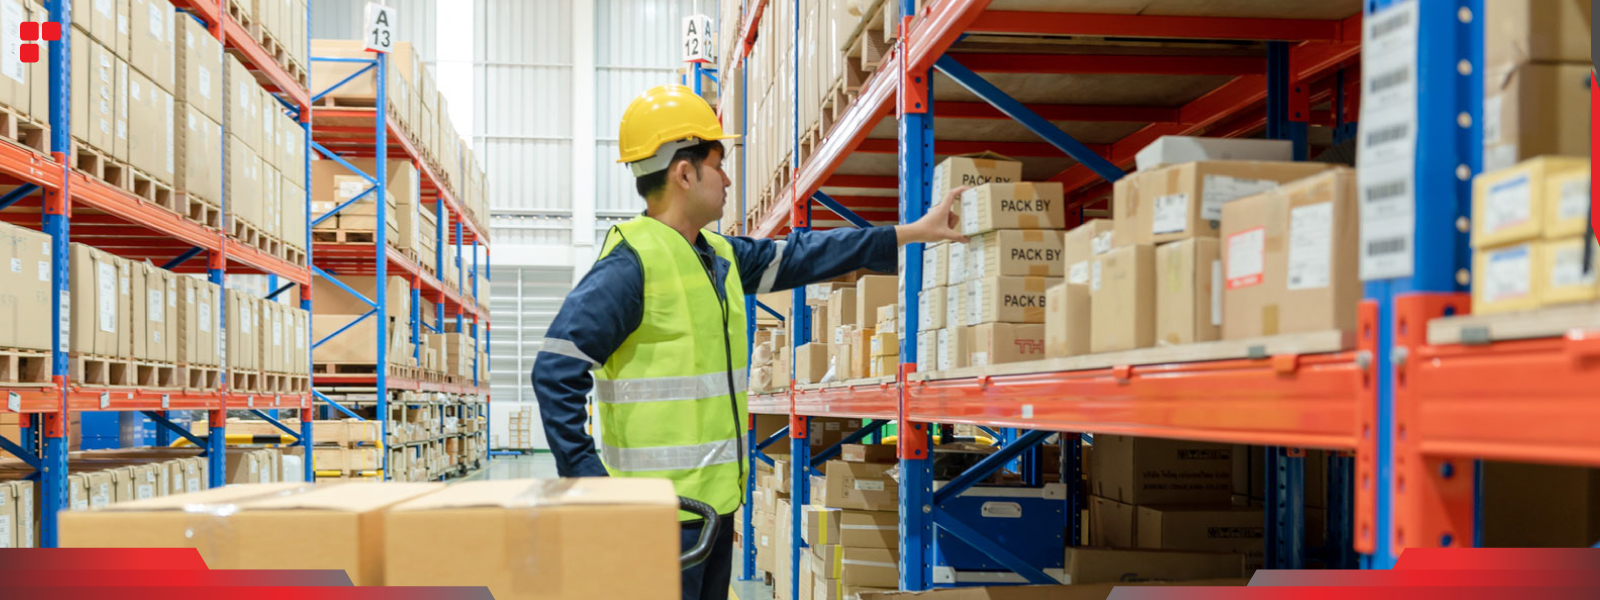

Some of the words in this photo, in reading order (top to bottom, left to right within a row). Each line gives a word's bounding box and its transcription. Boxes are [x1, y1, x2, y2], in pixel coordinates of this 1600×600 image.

[376, 10, 389, 27] A
[687, 19, 697, 36] A
[705, 20, 711, 37] A
[372, 28, 390, 47] 13
[685, 38, 699, 56] 12
[704, 39, 712, 58] 12
[962, 173, 991, 186] PACK
[1001, 200, 1032, 212] PACK
[1035, 200, 1051, 212] BY
[1011, 248, 1042, 261] PACK
[1045, 248, 1061, 261] BY
[1004, 294, 1036, 307] PACK
